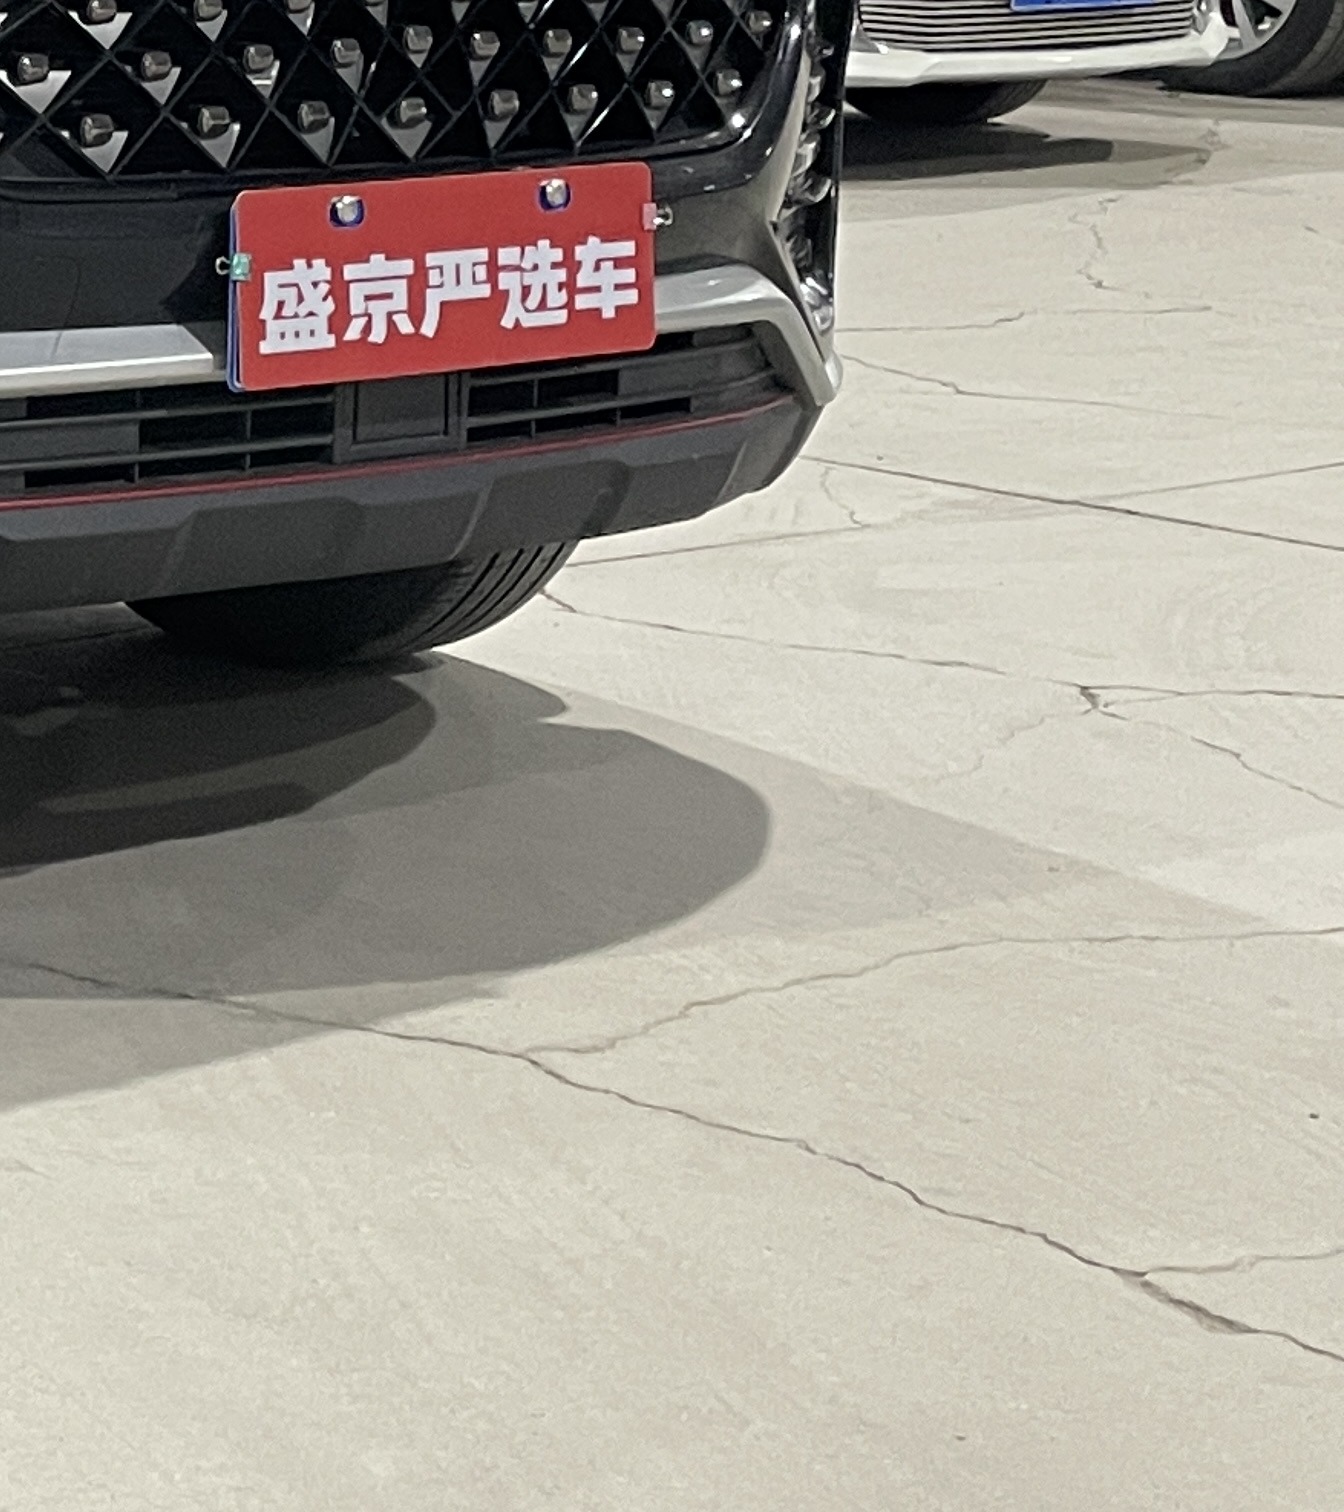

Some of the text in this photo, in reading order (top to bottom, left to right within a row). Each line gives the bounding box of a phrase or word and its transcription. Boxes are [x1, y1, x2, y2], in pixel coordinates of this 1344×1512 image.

[258, 235, 639, 355] 盛京严选车
